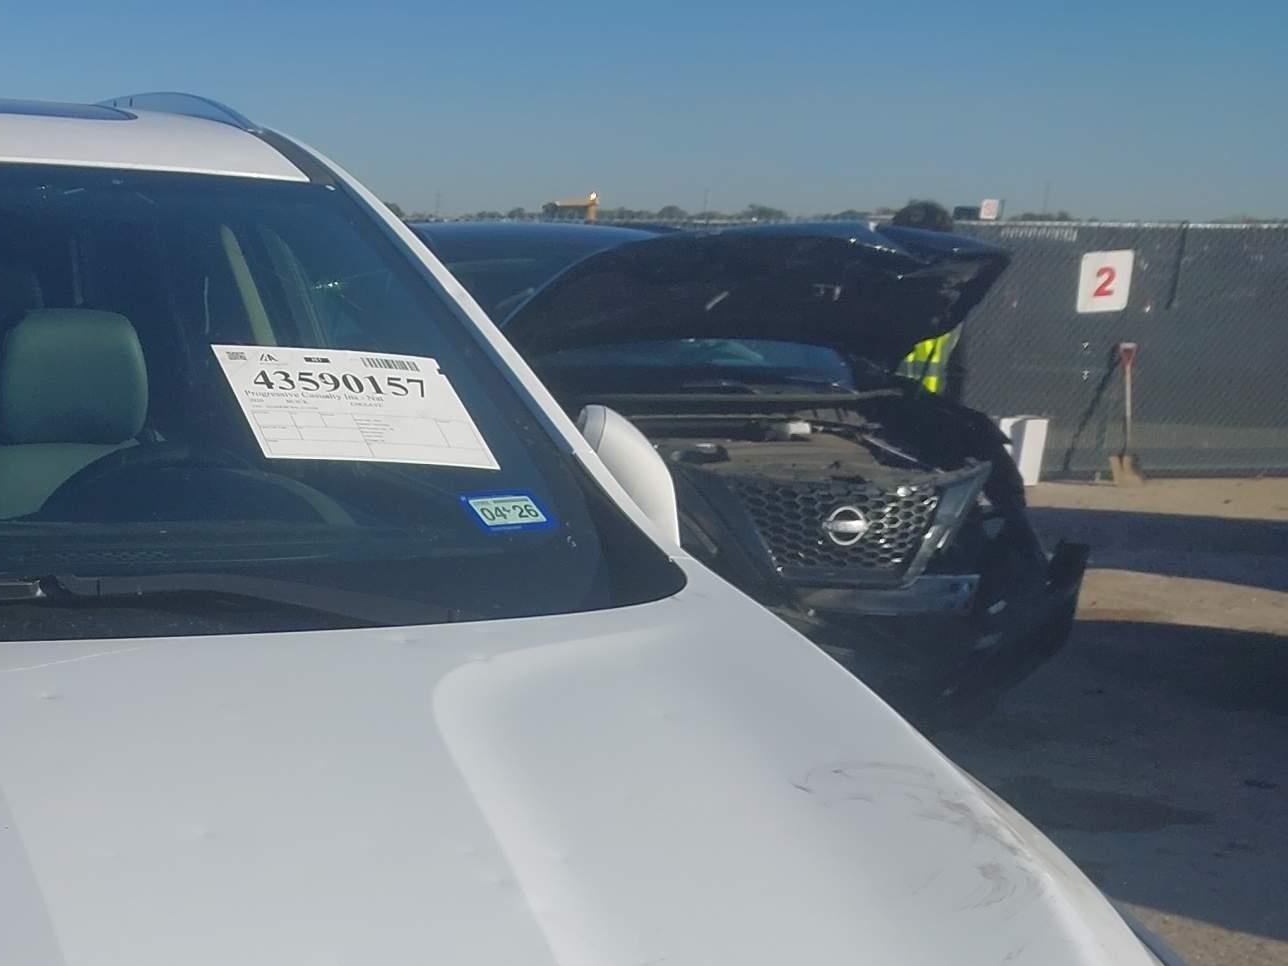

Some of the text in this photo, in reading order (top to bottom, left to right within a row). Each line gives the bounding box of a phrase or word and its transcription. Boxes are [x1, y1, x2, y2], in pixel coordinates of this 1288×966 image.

[1093, 267, 1116, 297] 2
[244, 389, 300, 399] Progressive
[301, 391, 341, 400] Casualty
[253, 369, 425, 398] 43590157
[480, 504, 539, 521] 04 26
